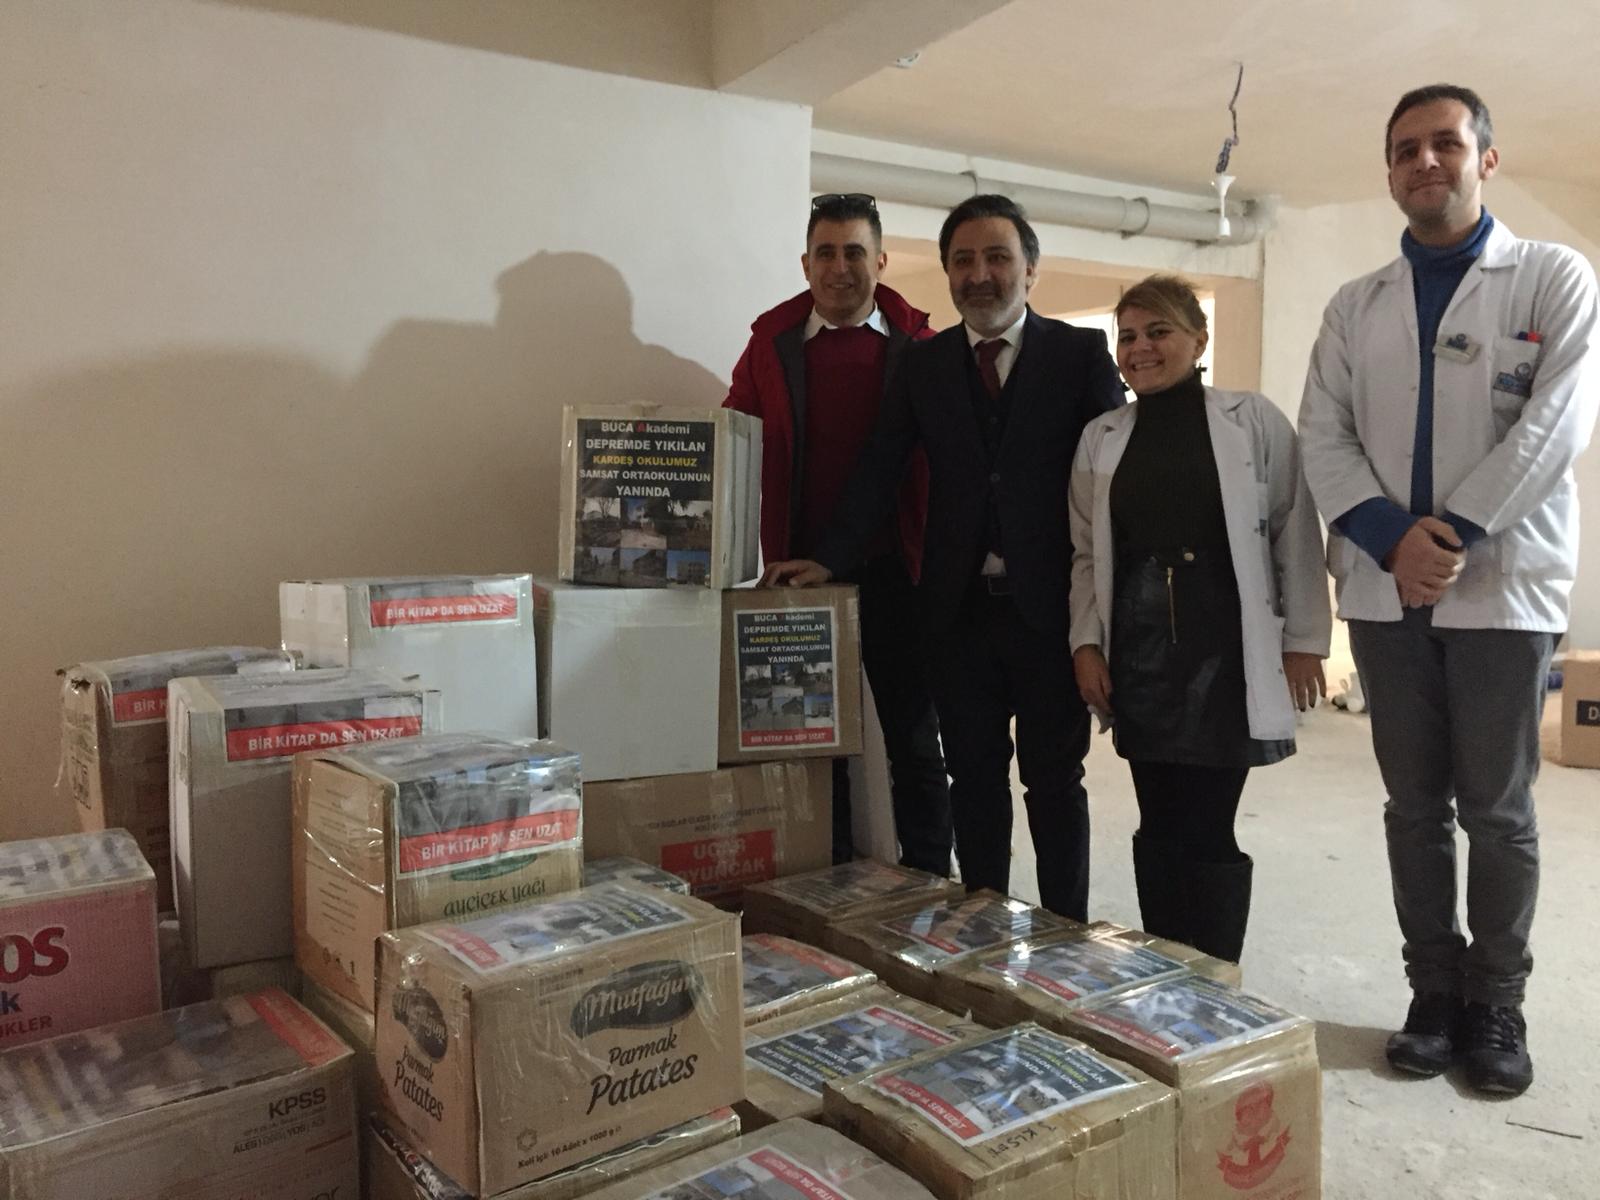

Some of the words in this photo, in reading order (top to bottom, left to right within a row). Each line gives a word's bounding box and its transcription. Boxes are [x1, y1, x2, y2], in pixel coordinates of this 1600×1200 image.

[601, 422, 634, 433] BUCA
[586, 439, 651, 450] DEPREMDE
[654, 440, 706, 452] YIKILAN
[592, 455, 634, 466] KARDEŞ
[637, 456, 698, 468] OKULUMUZ
[580, 469, 620, 480] SAMSAT
[622, 470, 711, 482] ORTAOKULUNUN
[616, 486, 671, 497] YANINDA
[386, 607, 406, 620] BİR
[408, 604, 438, 618] KİTAP
[440, 605, 454, 616] DA
[456, 604, 476, 616] SEN
[754, 614, 778, 622] BUCA
[744, 625, 790, 634] DEPREMDE
[792, 624, 826, 632] YIKILAN
[768, 655, 805, 664] YANINDA
[134, 698, 156, 714] BİR
[248, 735, 273, 751] BİR
[276, 732, 316, 750] KİTAP
[320, 731, 338, 744] DA
[342, 730, 367, 743] SEN
[422, 842, 446, 861] BİR
[450, 836, 489, 856] KİTAP
[509, 826, 533, 843] SEN
[608, 1027, 678, 1072] Parmak
[394, 1061, 444, 1122] Patates
[586, 1054, 698, 1116] Patates
[269, 1087, 326, 1119] KPSS
